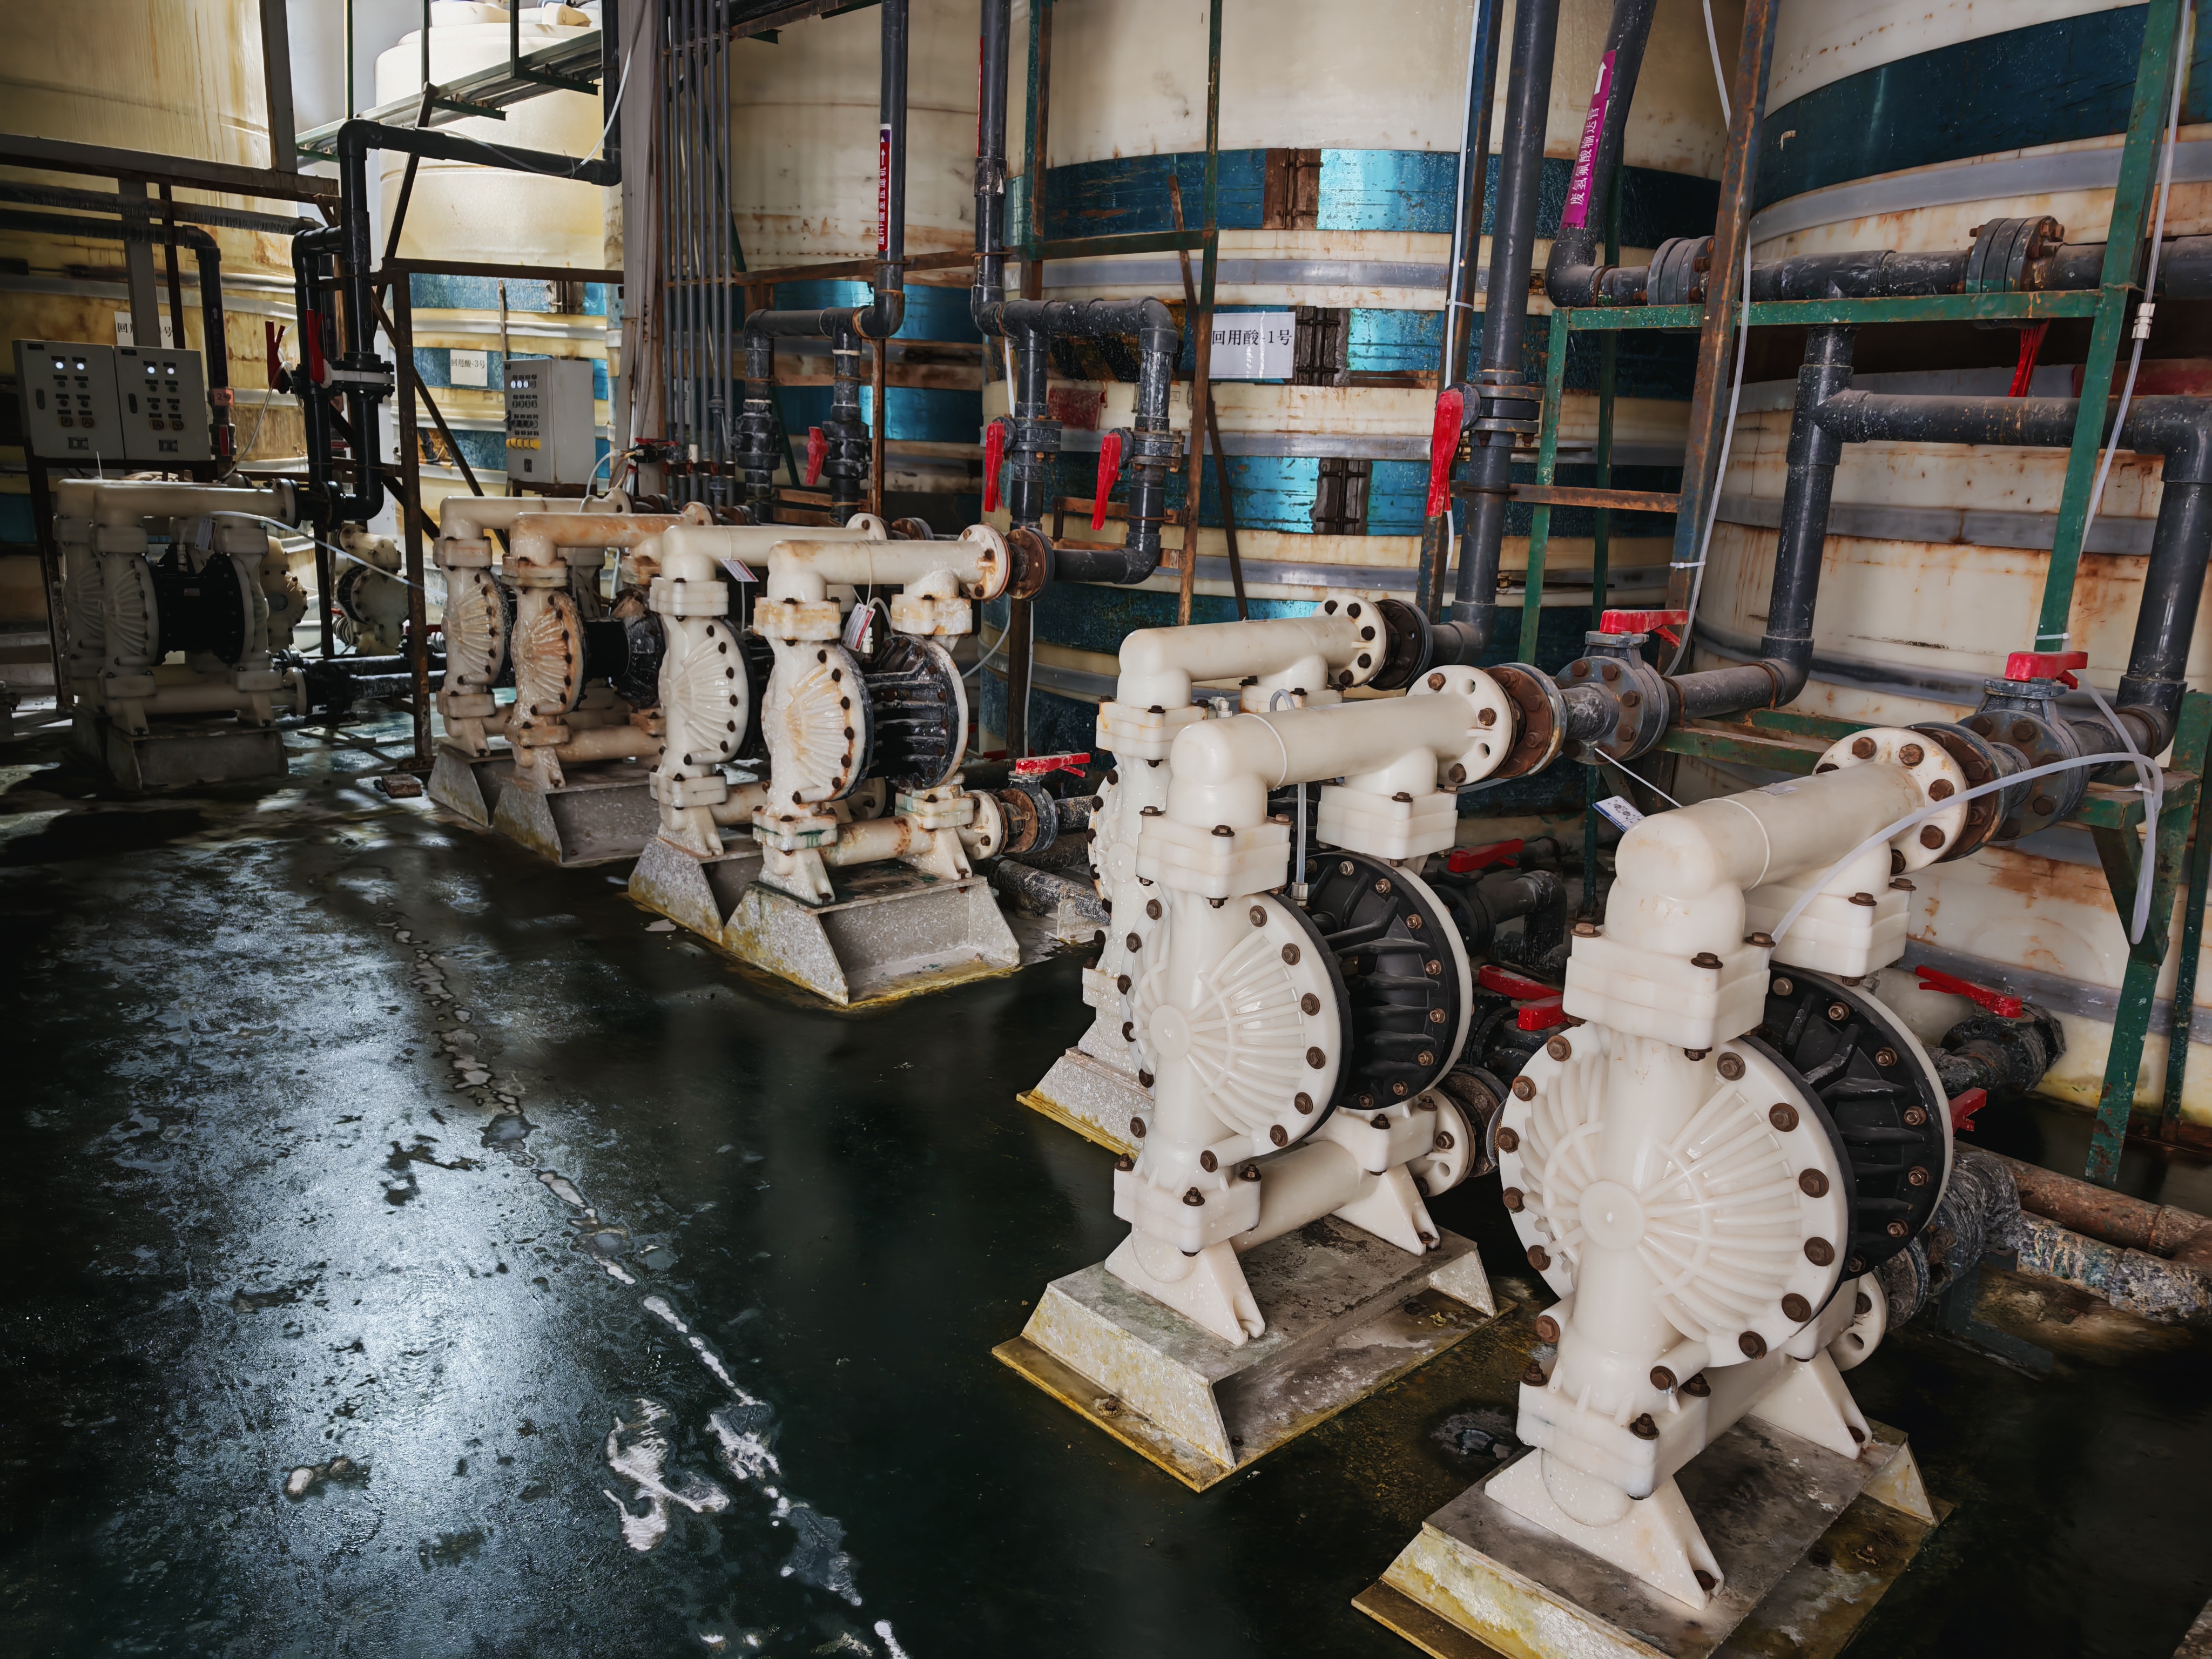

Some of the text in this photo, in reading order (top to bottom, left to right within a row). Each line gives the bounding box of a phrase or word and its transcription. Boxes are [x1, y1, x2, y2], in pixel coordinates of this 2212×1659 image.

[1212, 329, 1292, 346] 回用酸-1号
[451, 359, 486, 369] 回用酸-3号
